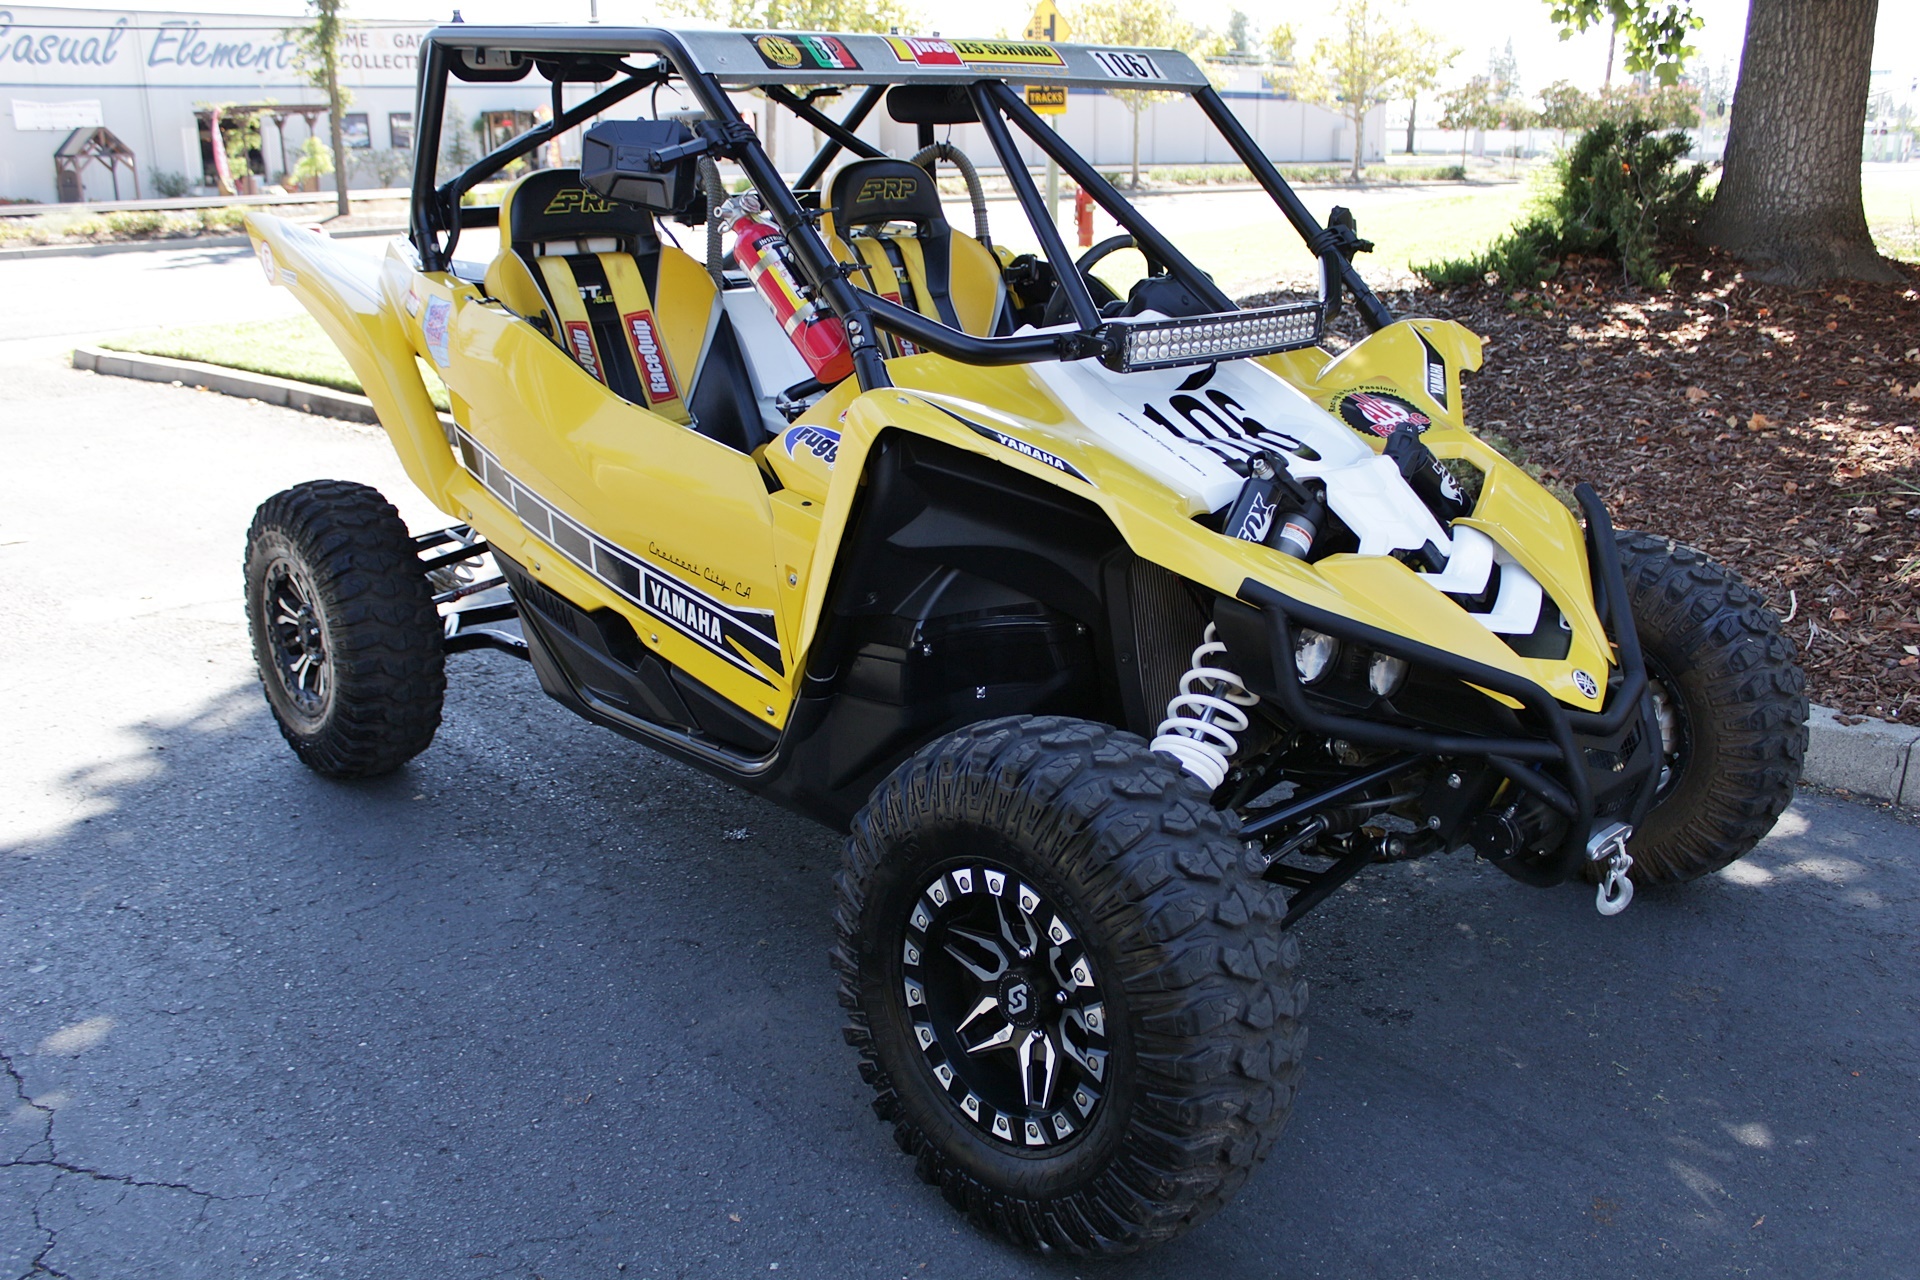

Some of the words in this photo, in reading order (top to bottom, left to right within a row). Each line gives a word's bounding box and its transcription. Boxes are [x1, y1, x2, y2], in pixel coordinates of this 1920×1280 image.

[904, 38, 953, 56] Tires
[953, 41, 985, 55] LES
[985, 43, 1053, 58] SCHWAB
[1095, 52, 1161, 79] 1067
[1029, 92, 1064, 103] TRACKS
[856, 178, 918, 203] PRP
[632, 319, 670, 393] RaceQuip
[1359, 385, 1397, 394] Passion!
[1429, 363, 1444, 395] YAMAHA
[796, 427, 839, 464] rugg
[997, 433, 1065, 470] YAMAHA
[648, 541, 701, 576] Crescent
[735, 582, 752, 600] CA
[649, 580, 723, 645] YAMAHA
